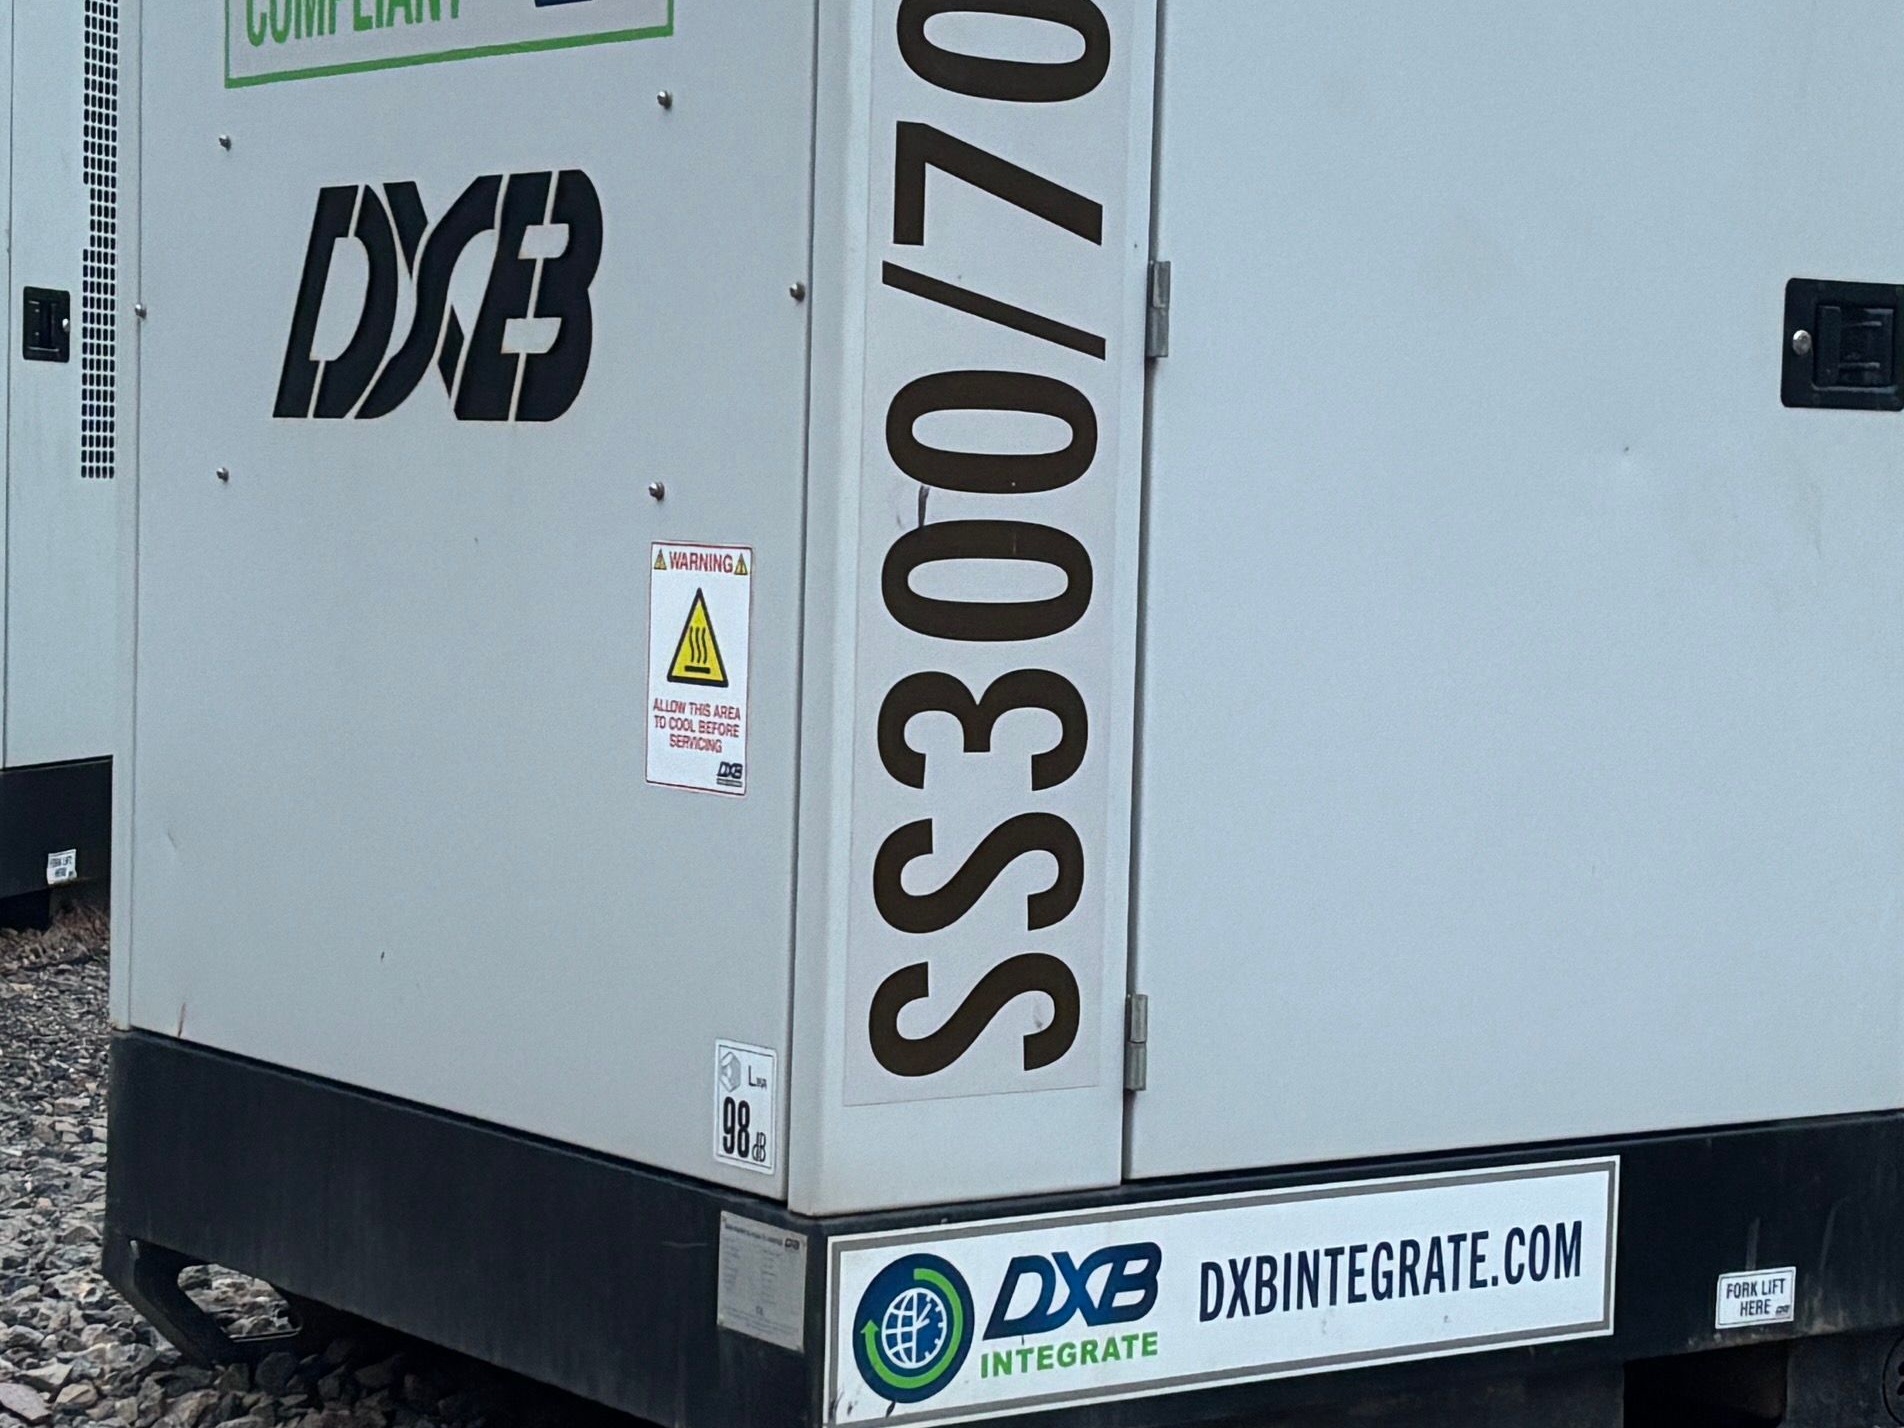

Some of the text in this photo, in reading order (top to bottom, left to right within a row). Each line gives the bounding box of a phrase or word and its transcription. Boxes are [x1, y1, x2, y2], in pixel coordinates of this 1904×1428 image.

[272, 169, 603, 422] DXB
[669, 551, 733, 573] WARNING
[653, 698, 741, 721] ALLOW THIS AREA
[654, 715, 740, 738] TO COOL BEFORE
[669, 733, 723, 754] SERVICING
[723, 1096, 766, 1162] 98 dB
[982, 1220, 1582, 1340] DXB DXBINTEGRATE.COM
[1726, 1278, 1786, 1299] FORK LIFT
[1740, 1298, 1772, 1317] HERE
[981, 1331, 1159, 1379] INTEGRATE
